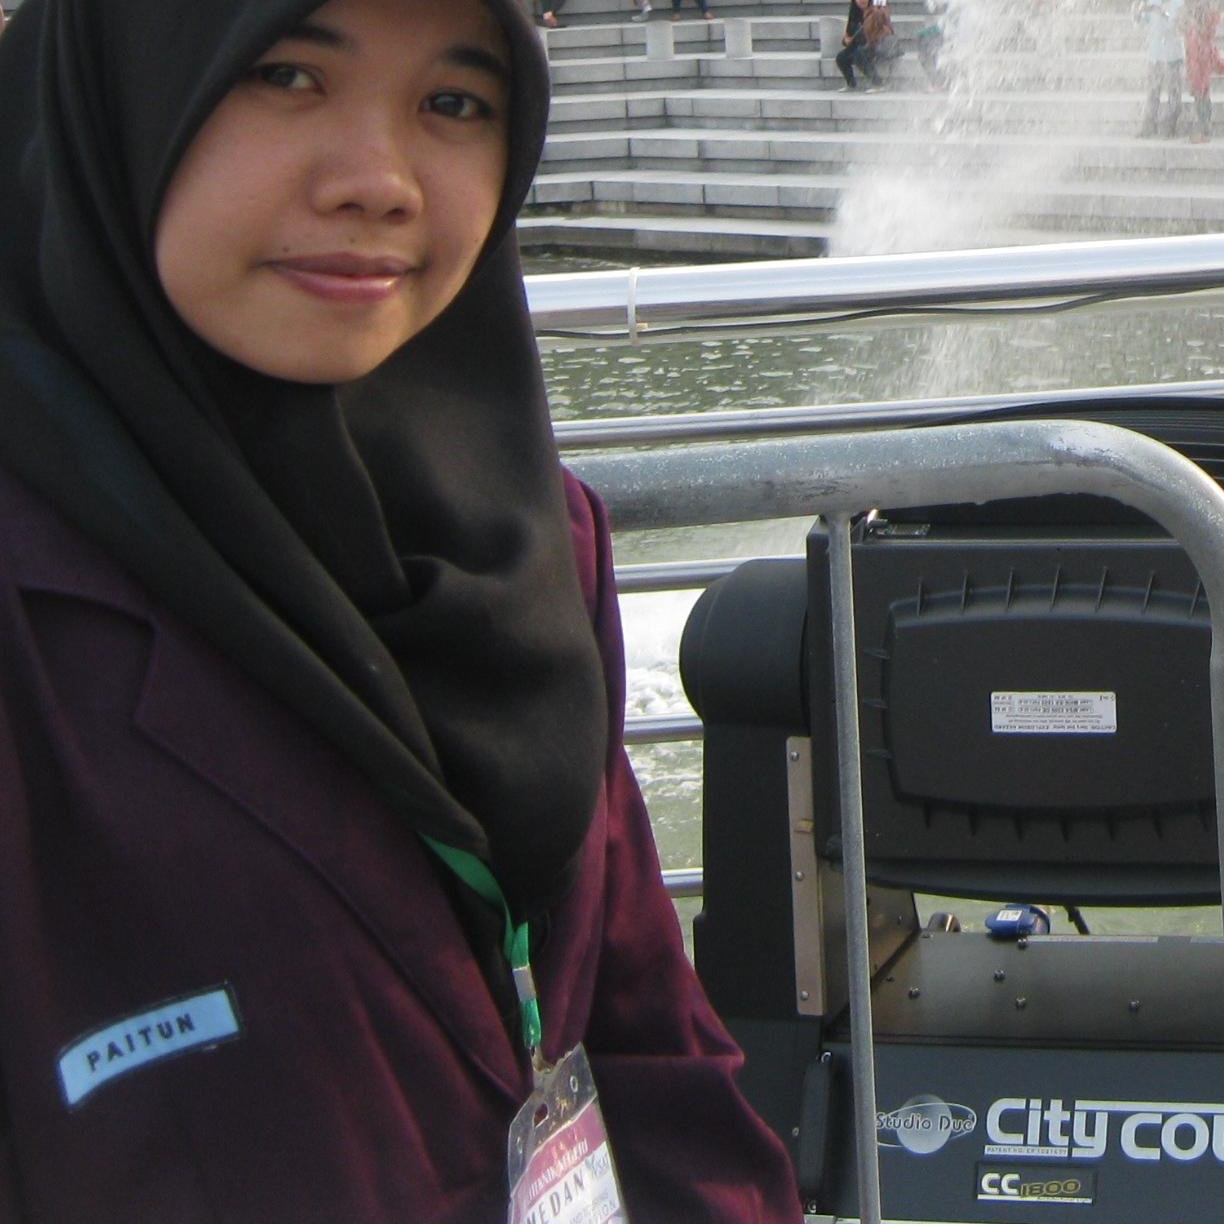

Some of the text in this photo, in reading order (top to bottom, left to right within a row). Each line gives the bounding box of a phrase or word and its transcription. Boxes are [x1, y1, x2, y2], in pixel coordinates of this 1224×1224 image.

[86, 1013, 195, 1073] PAITUN
[876, 1112, 931, 1131] Studio
[986, 1097, 1109, 1158] City
